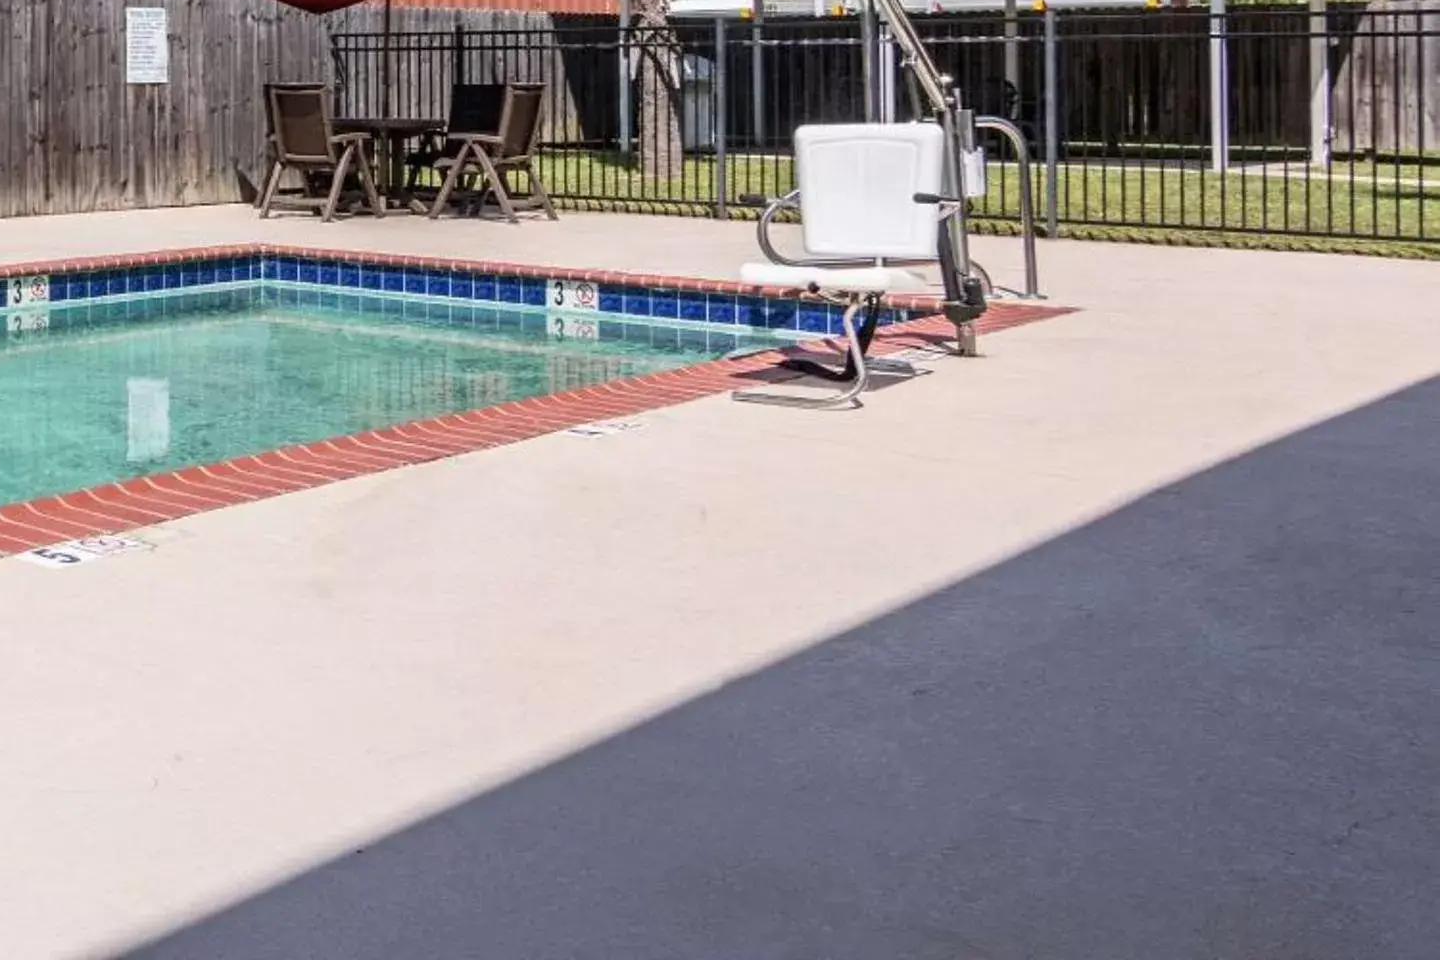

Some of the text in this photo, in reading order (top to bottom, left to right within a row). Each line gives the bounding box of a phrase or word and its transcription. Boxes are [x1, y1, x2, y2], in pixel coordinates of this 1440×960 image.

[13, 279, 22, 304] 3
[554, 281, 564, 306] 3
[32, 548, 82, 564] 5
